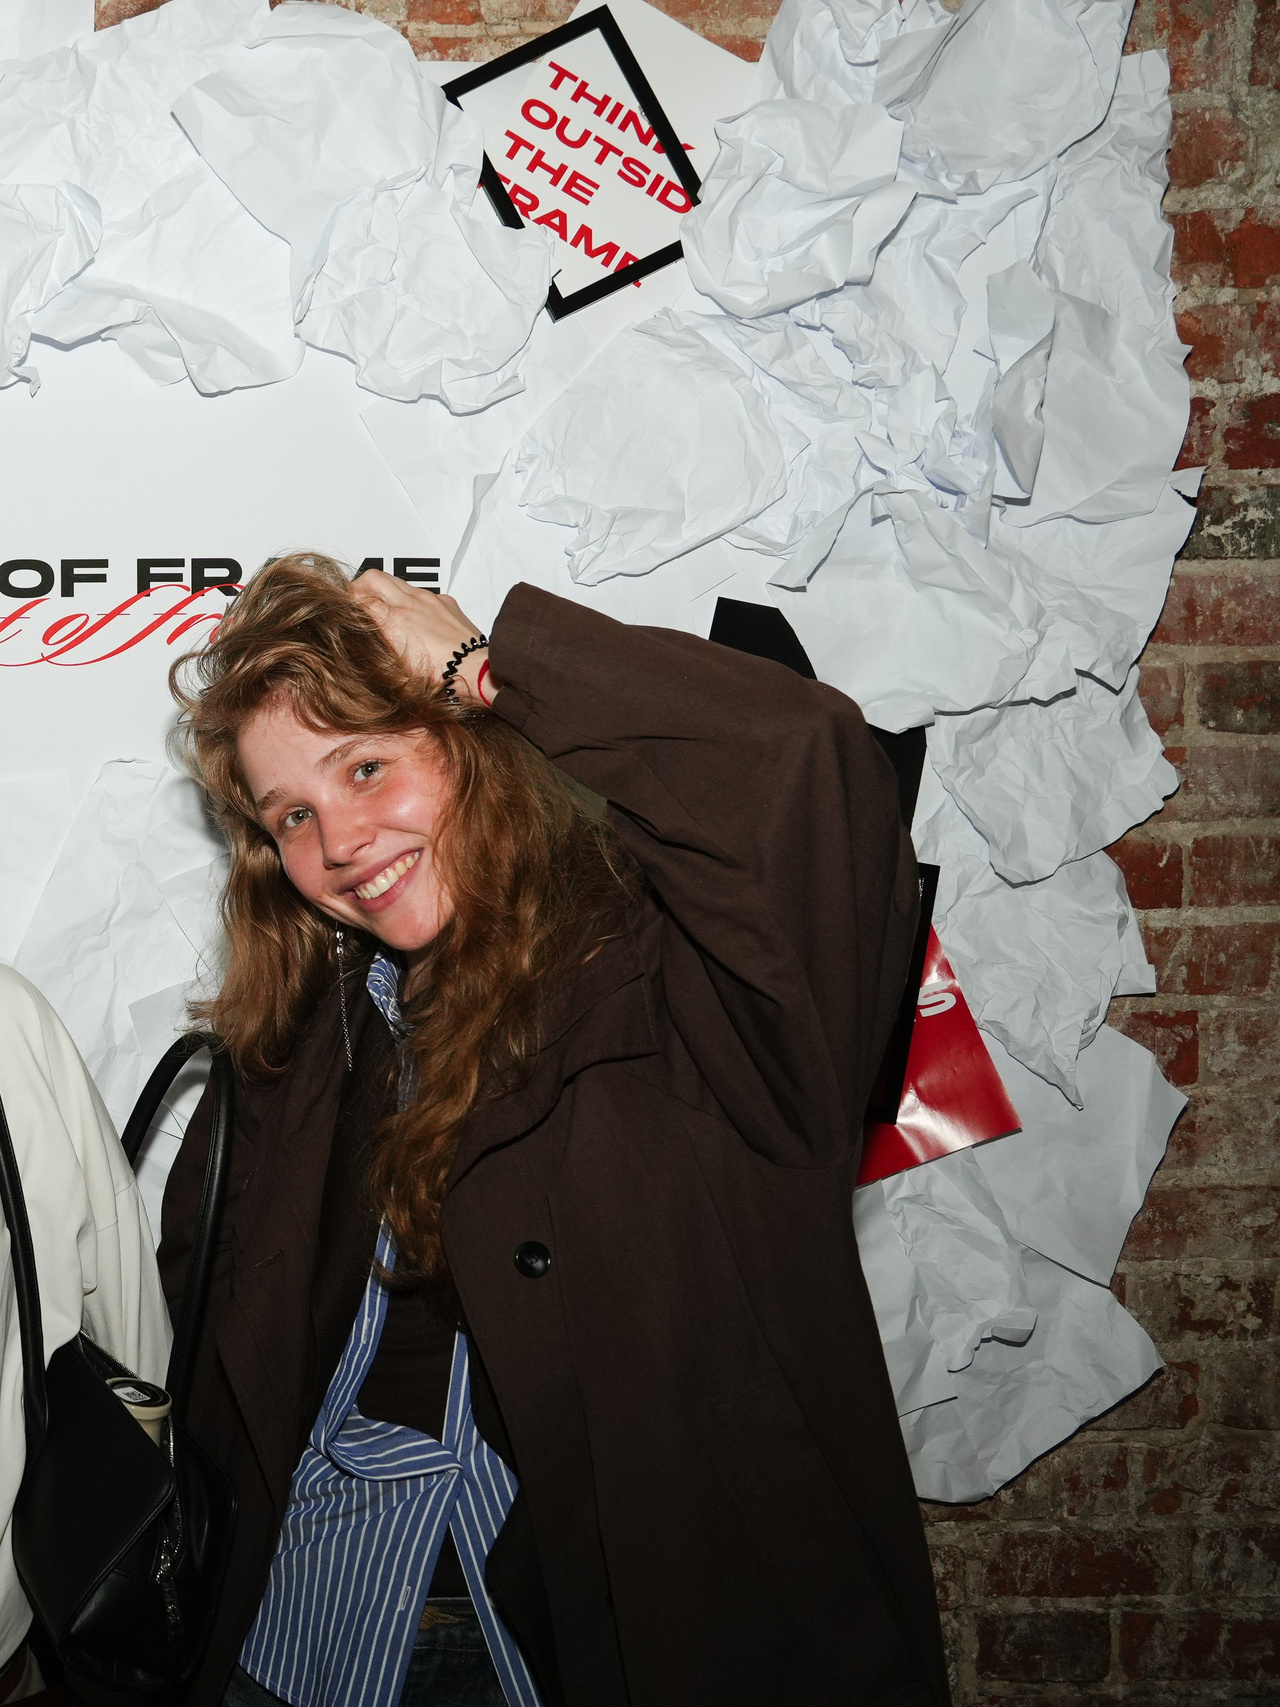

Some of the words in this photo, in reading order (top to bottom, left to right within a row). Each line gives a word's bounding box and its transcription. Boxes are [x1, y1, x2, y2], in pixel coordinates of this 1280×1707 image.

[504, 130, 600, 206] THE
[521, 99, 695, 214] OUTSID
[477, 171, 642, 288] RAM
[137, 557, 440, 597] FRE
